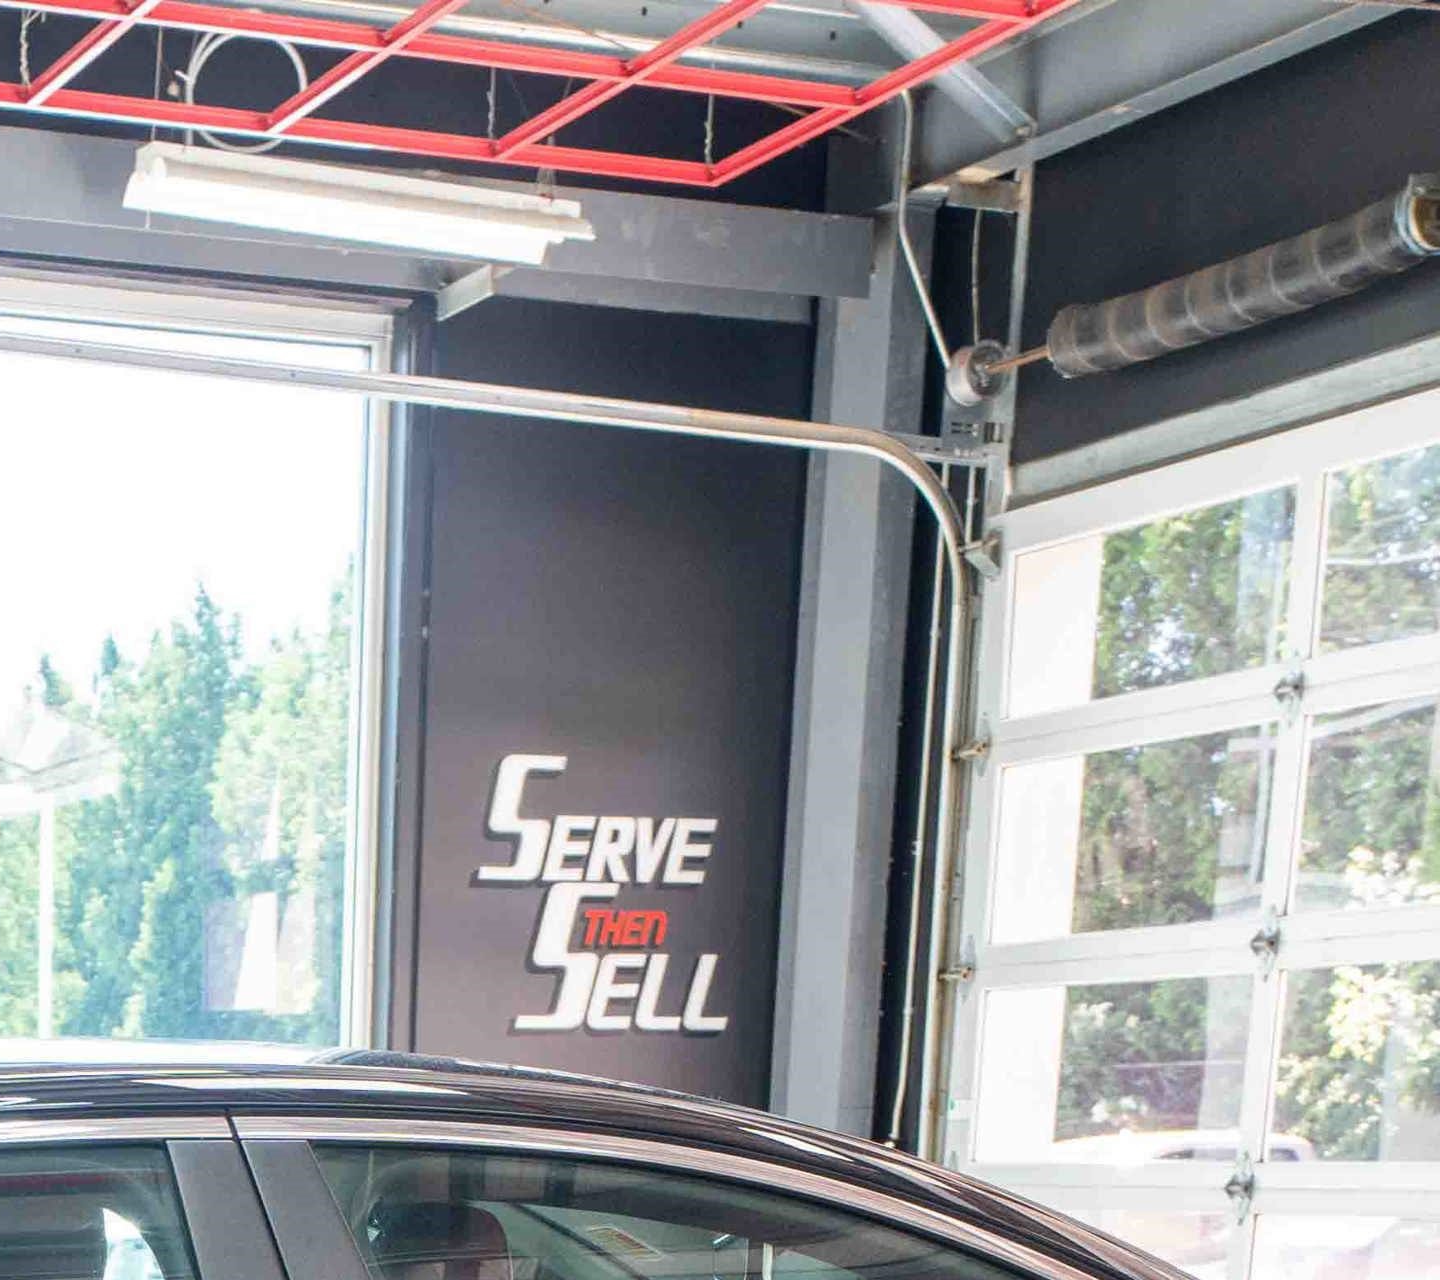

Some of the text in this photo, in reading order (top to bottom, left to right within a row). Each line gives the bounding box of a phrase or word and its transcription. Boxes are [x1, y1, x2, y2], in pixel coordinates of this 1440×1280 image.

[478, 754, 718, 884] SERVE
[514, 881, 729, 1031] SELL
[583, 908, 669, 946] THEN
